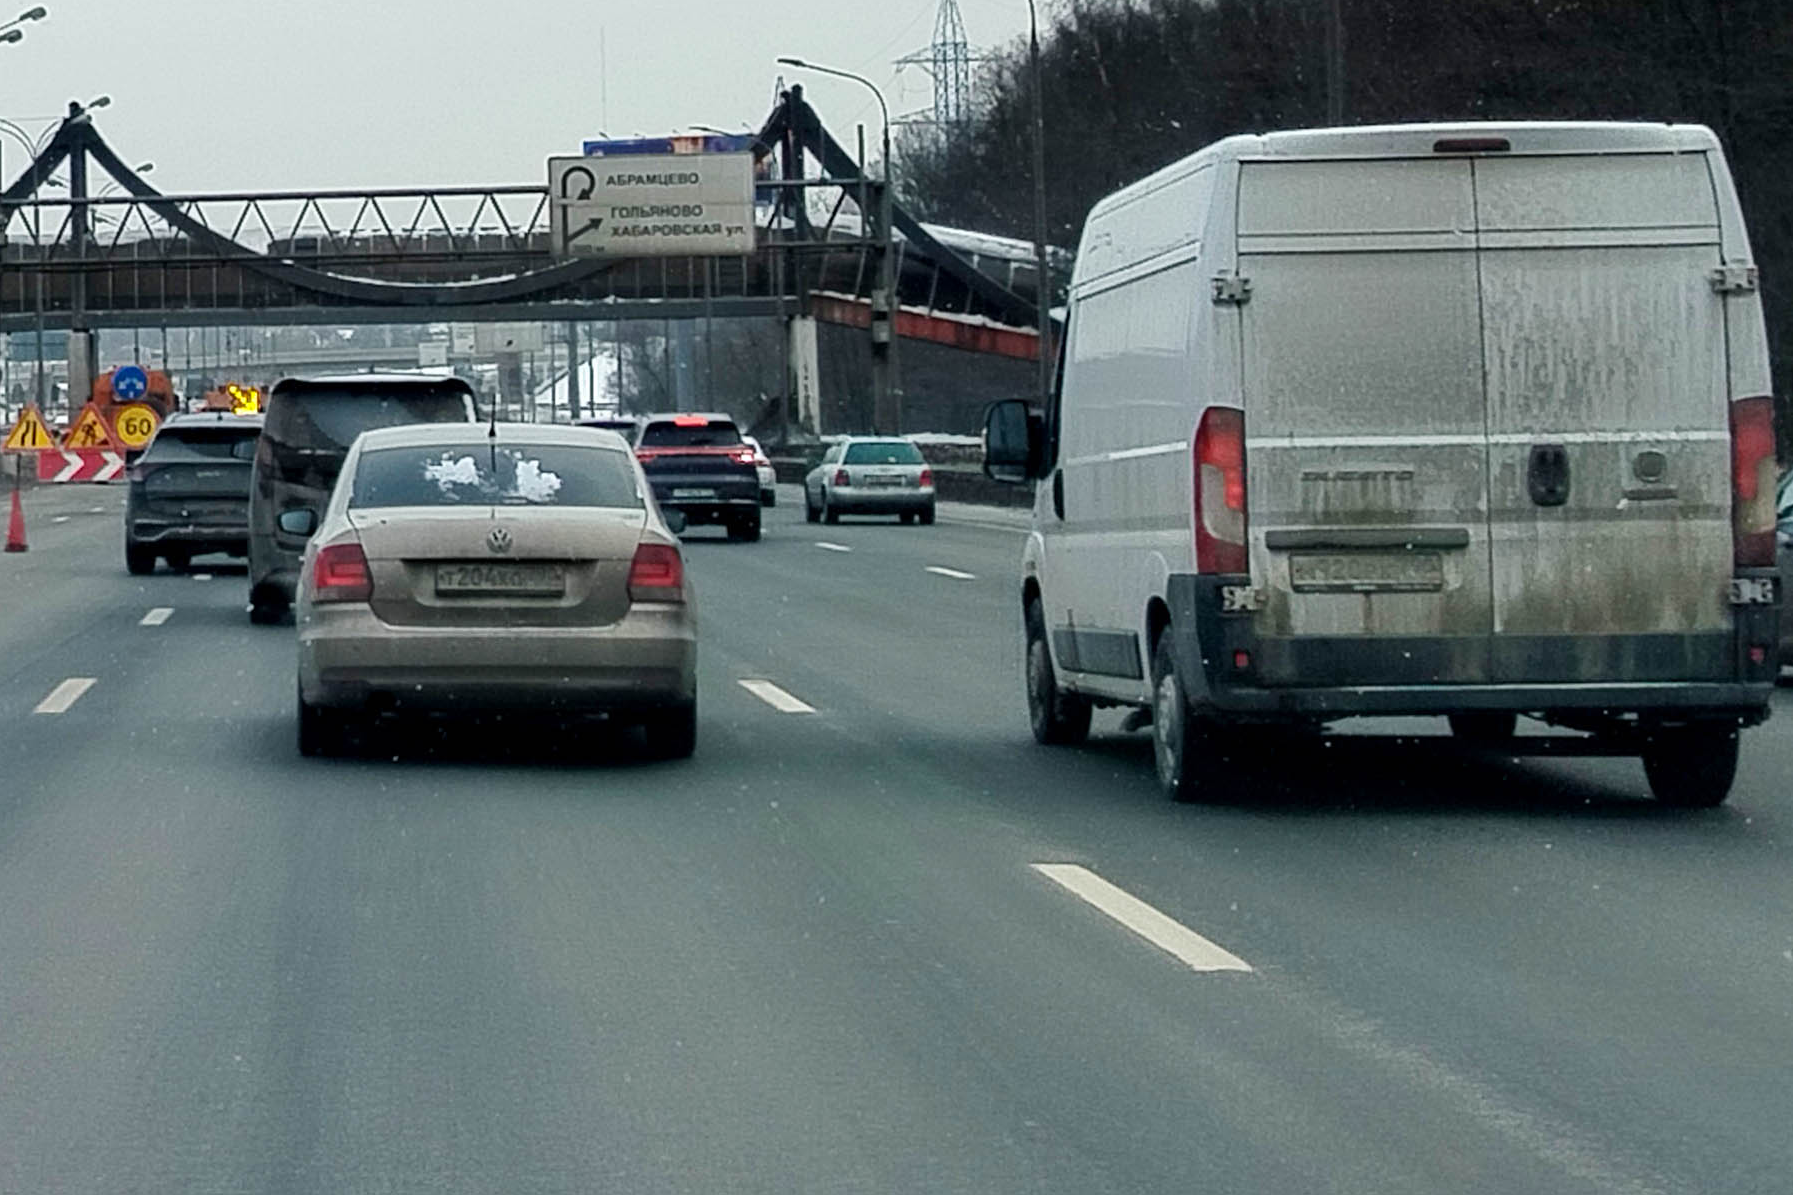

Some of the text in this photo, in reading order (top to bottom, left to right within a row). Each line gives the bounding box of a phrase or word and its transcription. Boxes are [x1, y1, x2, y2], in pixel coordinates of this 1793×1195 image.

[606, 172, 699, 186] АБРАМЦЕВО
[610, 204, 703, 219] ГОЛЬЯНОВО
[610, 224, 722, 237] ХАБАРОВСКАЯ
[125, 417, 152, 436] 60
